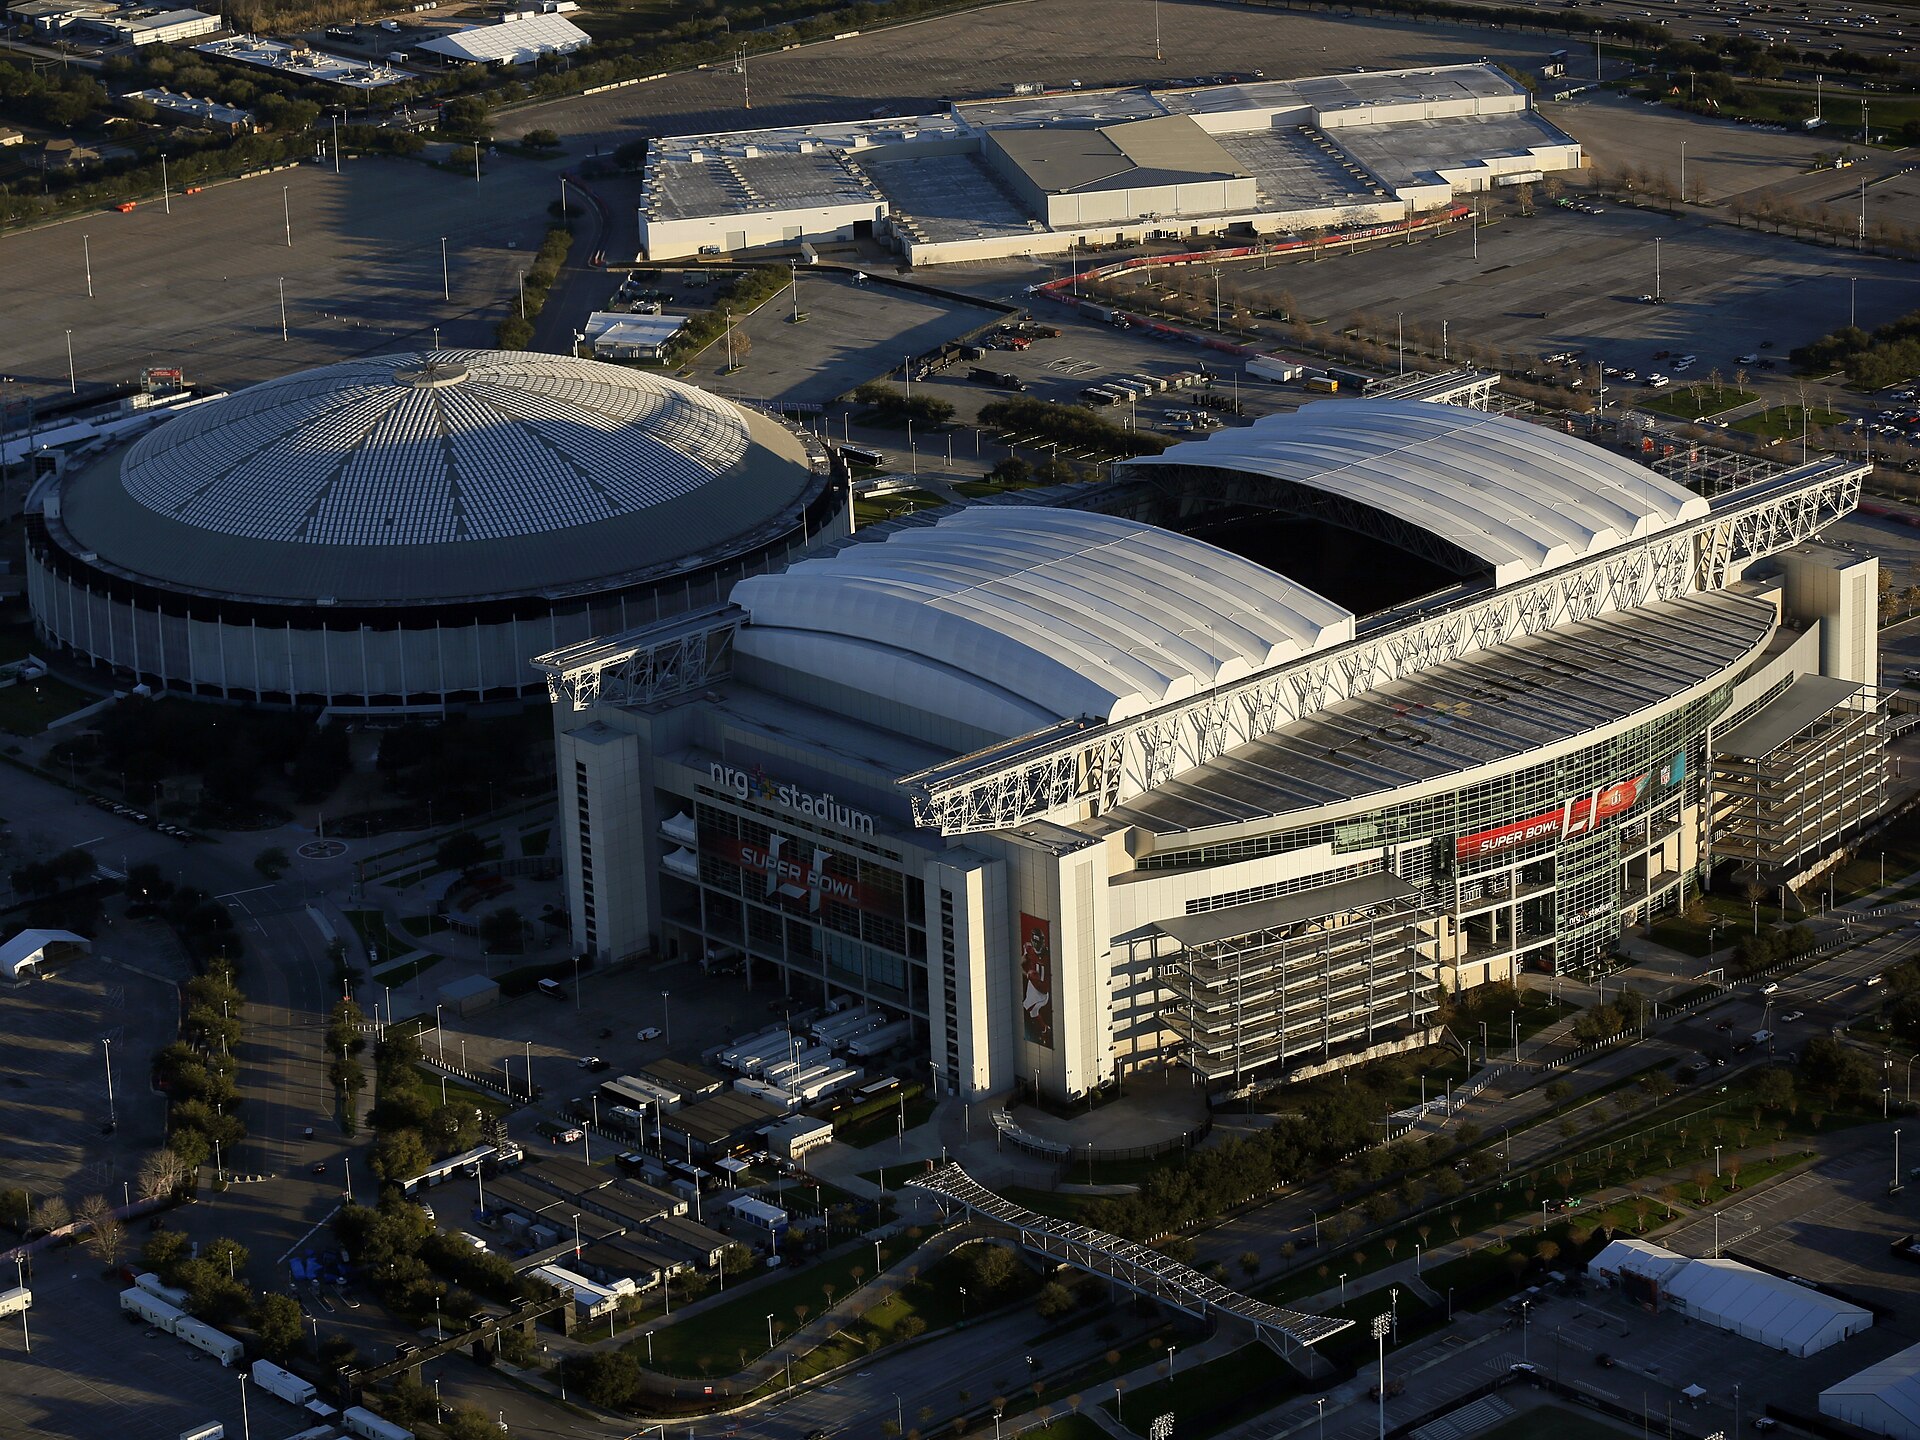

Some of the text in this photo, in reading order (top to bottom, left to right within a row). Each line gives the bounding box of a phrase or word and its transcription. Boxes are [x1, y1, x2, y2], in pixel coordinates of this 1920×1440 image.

[710, 762, 875, 836] nrg stadium
[1480, 831, 1523, 852] SUPER
[1525, 820, 1560, 840] BOWL
[740, 847, 858, 903] SUPER BOWL
